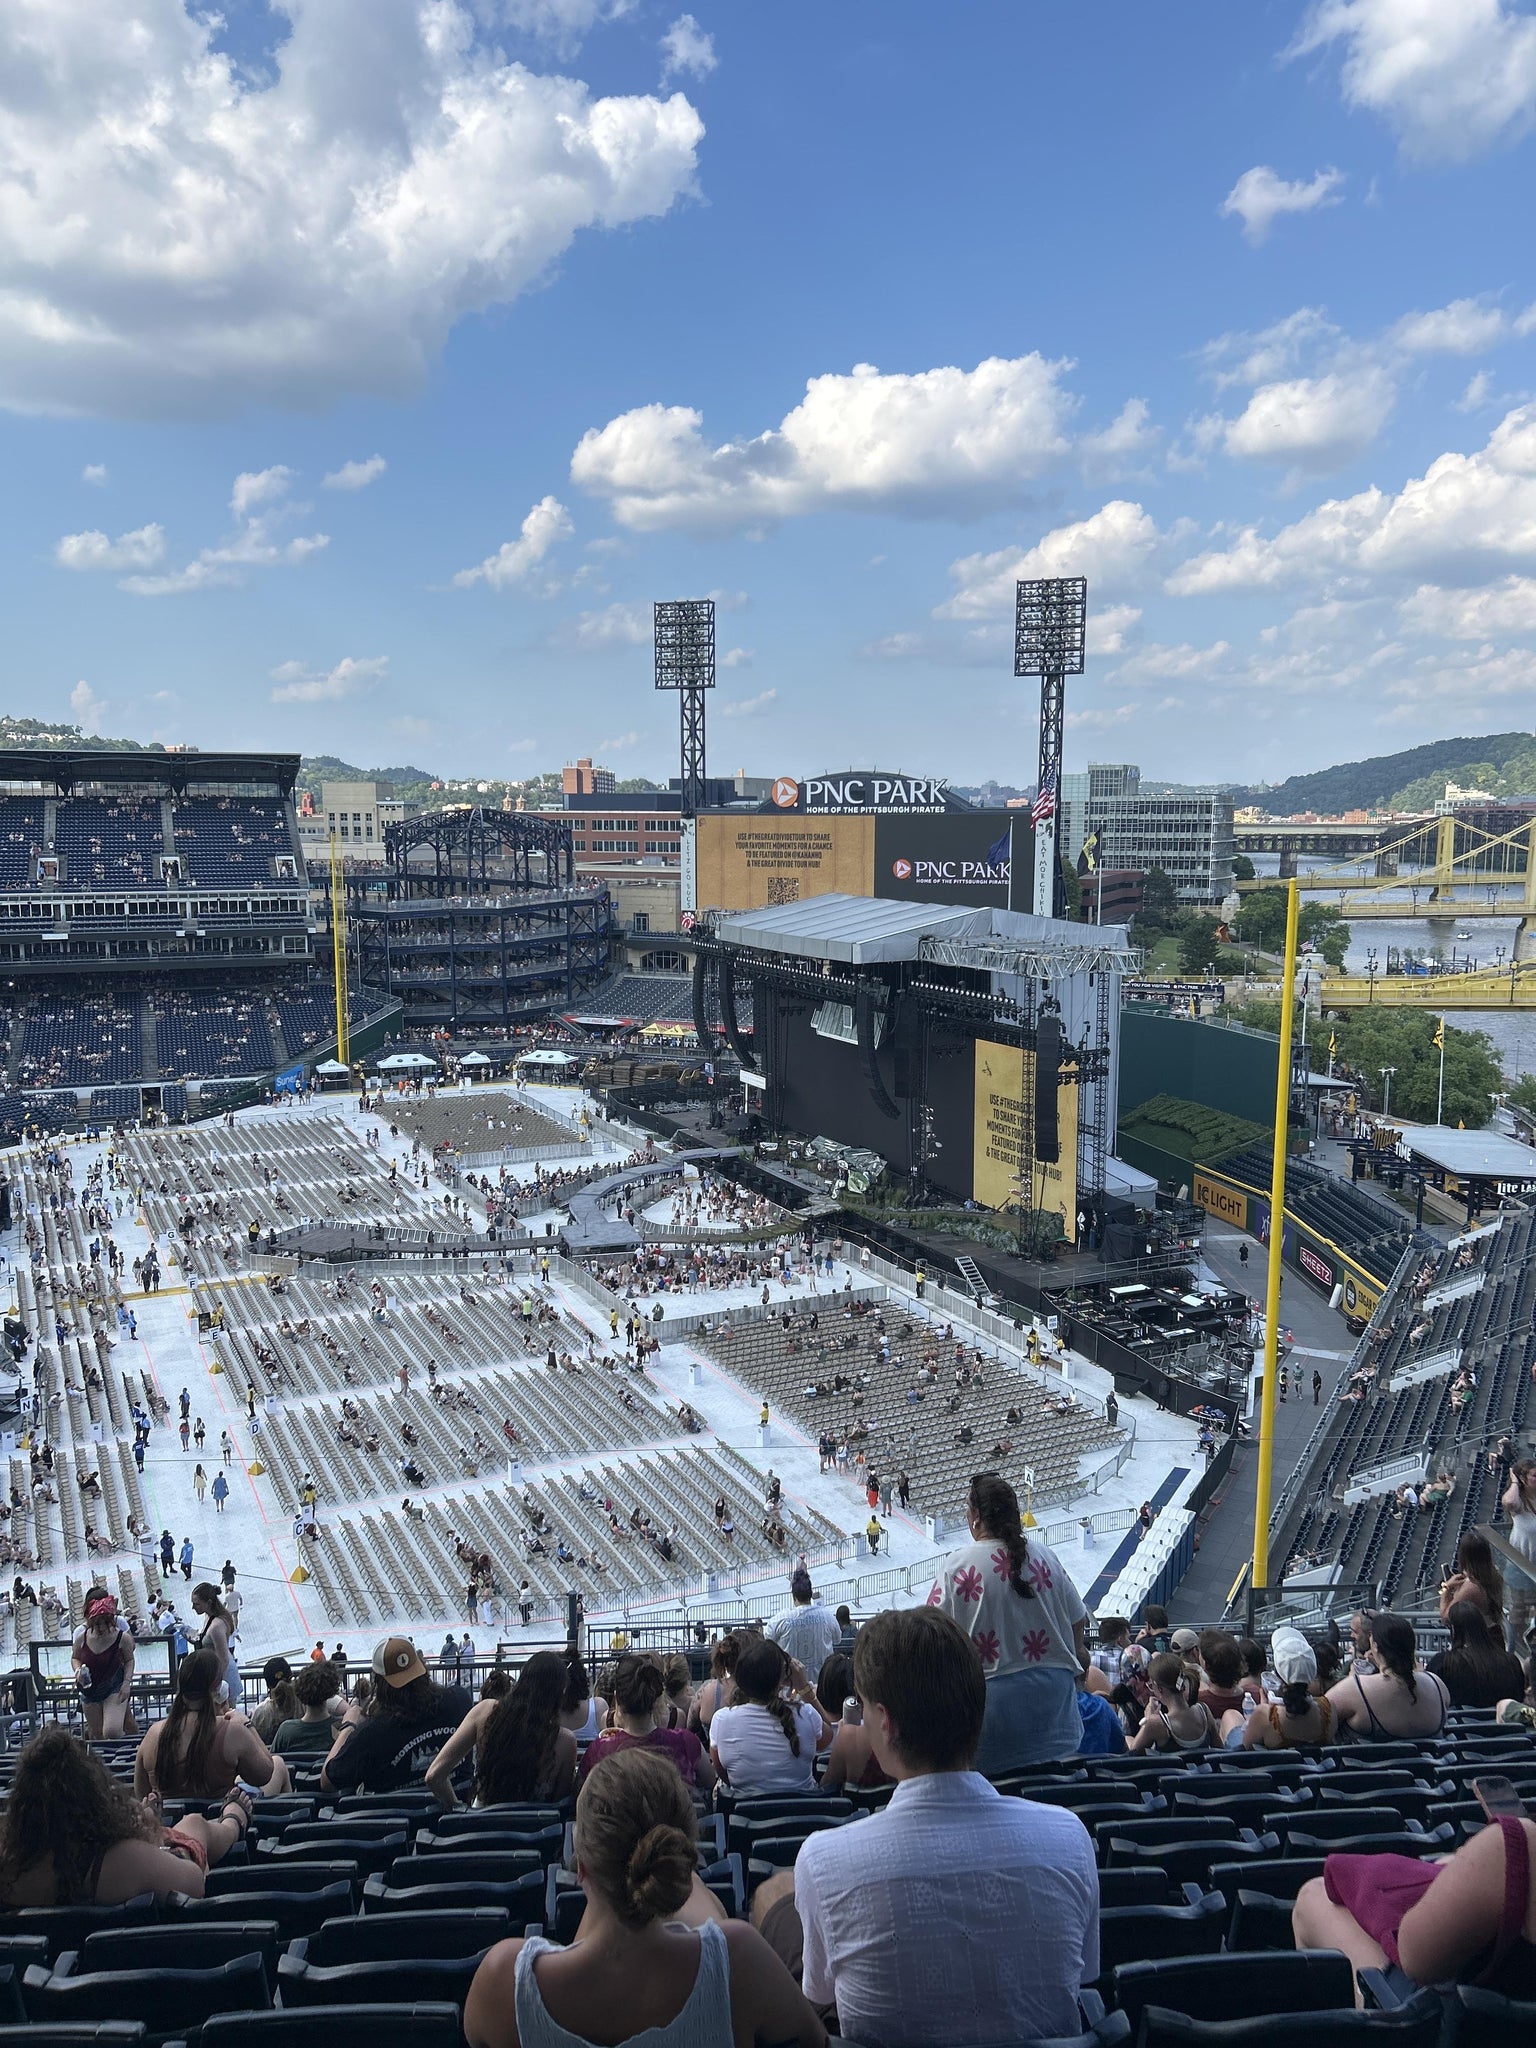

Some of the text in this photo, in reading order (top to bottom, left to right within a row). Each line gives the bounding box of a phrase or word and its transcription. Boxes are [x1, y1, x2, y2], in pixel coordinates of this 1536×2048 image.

[803, 780, 947, 804] PNC PARK
[737, 833, 747, 841] USE
[806, 833, 813, 841] TO
[813, 833, 830, 841] SHARE
[735, 842, 748, 850] YOUR
[749, 842, 771, 850] FAVORITE
[772, 842, 797, 850] MOMENTS
[797, 842, 808, 850] FOR
[812, 842, 832, 850] CHANCE
[759, 851, 783, 859] FEATURED
[761, 860, 776, 868] GREAT
[777, 860, 794, 868] DIVIDE
[794, 860, 807, 868] TOUR
[914, 861, 1010, 878] PNC PARK
[989, 1093, 999, 1106] USE
[993, 1108, 999, 1120] TO
[1000, 1110, 1016, 1125] SHARE
[986, 1120, 1011, 1137] MOMENTS
[991, 1134, 1016, 1152] FEATURED
[1371, 1126, 1402, 1151] Miller
[1395, 1142, 1411, 1162] TIME
[986, 1146, 990, 1157] &
[990, 1147, 1000, 1161] THE
[1001, 1151, 1016, 1166] GREAT
[1034, 1162, 1048, 1177] TOUR
[1048, 1167, 1062, 1182] HUB!
[1496, 1182, 1518, 1196] Lite
[1197, 1183, 1242, 1218] IC LIGHT
[1301, 1250, 1330, 1282] SHEETZ
[212, 1331, 218, 1340] E
[22, 1400, 30, 1411] N
[252, 1423, 259, 1434] D
[295, 1523, 303, 1535] C
[391, 1727, 457, 1767] MORNING WOO
